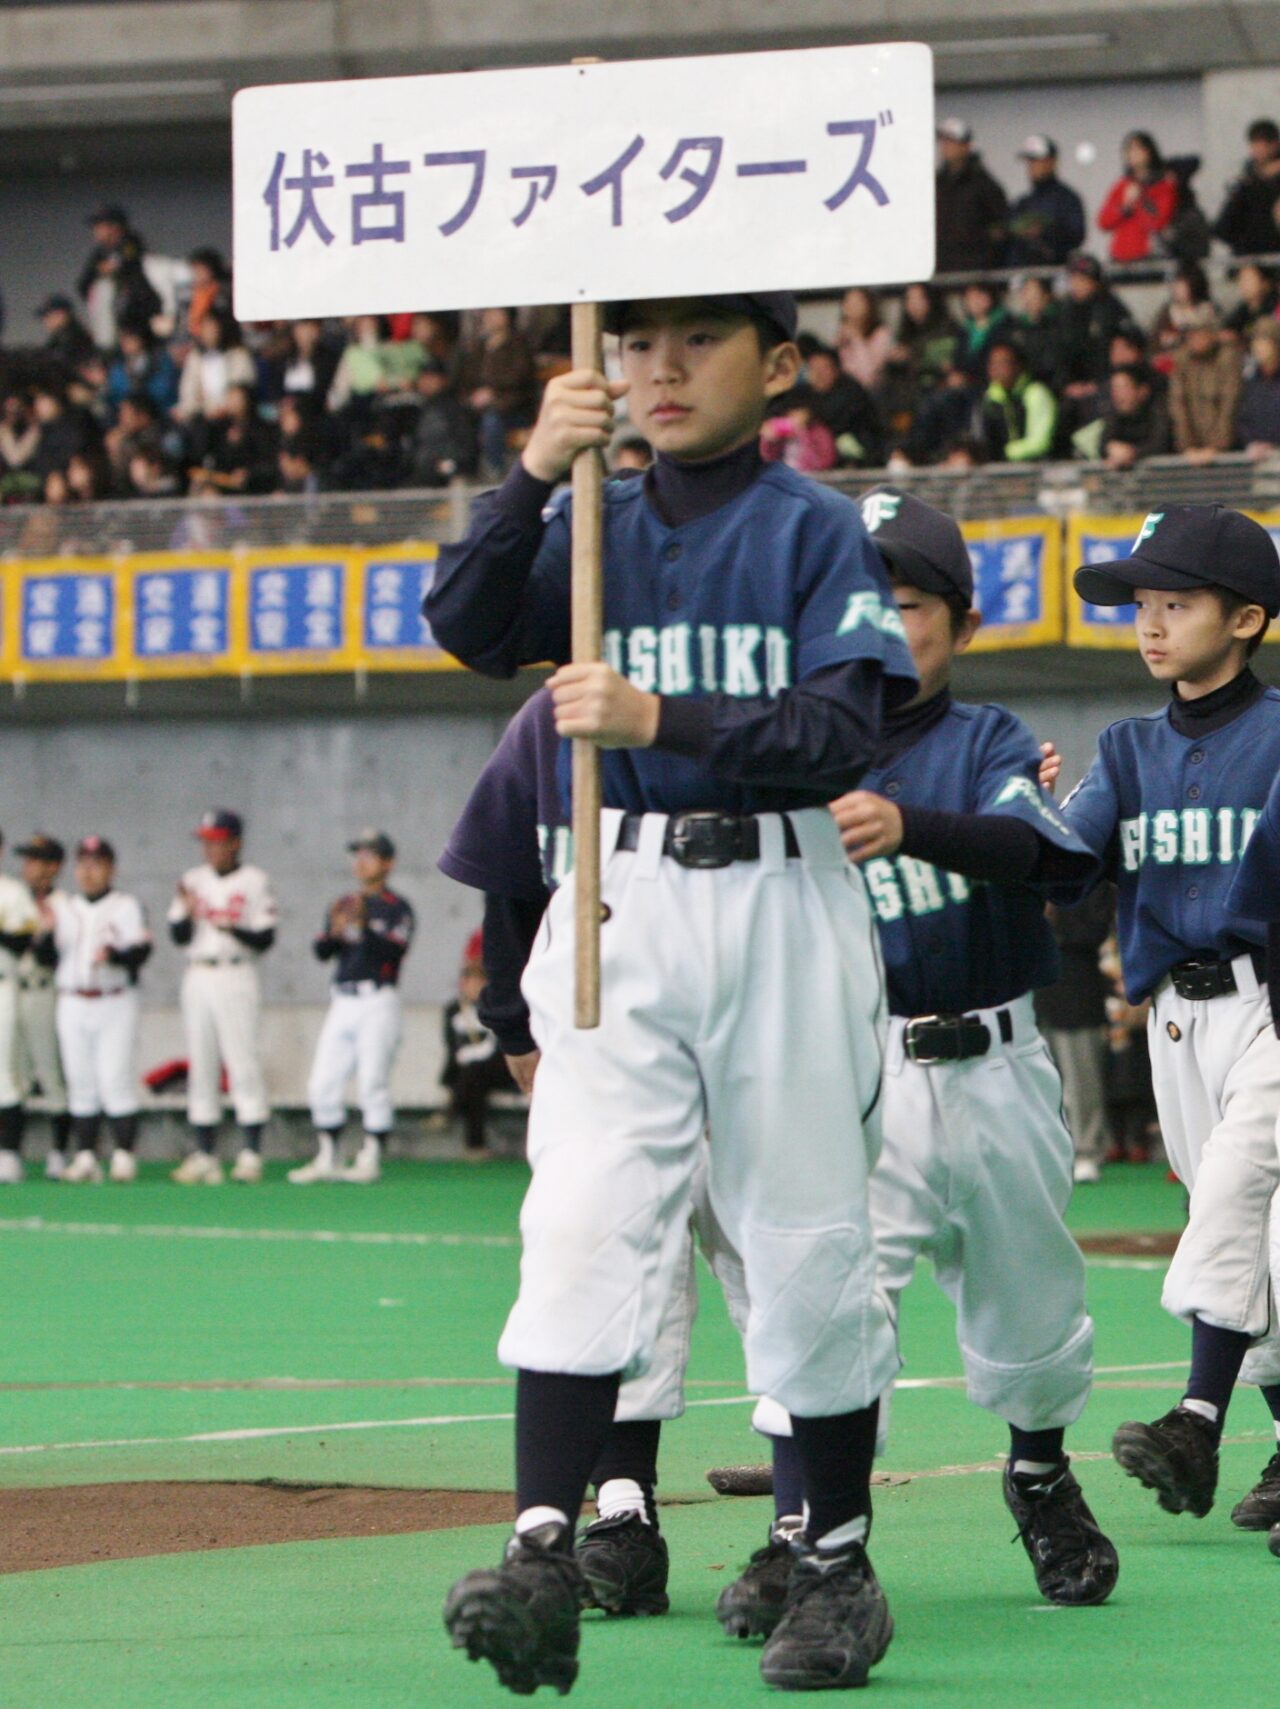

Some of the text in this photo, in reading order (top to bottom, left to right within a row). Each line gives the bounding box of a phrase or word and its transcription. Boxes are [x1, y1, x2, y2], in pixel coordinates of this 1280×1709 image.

[262, 109, 894, 251] 伏古ファイターズ
[861, 492, 902, 533] F
[604, 621, 793, 698] SHIKO
